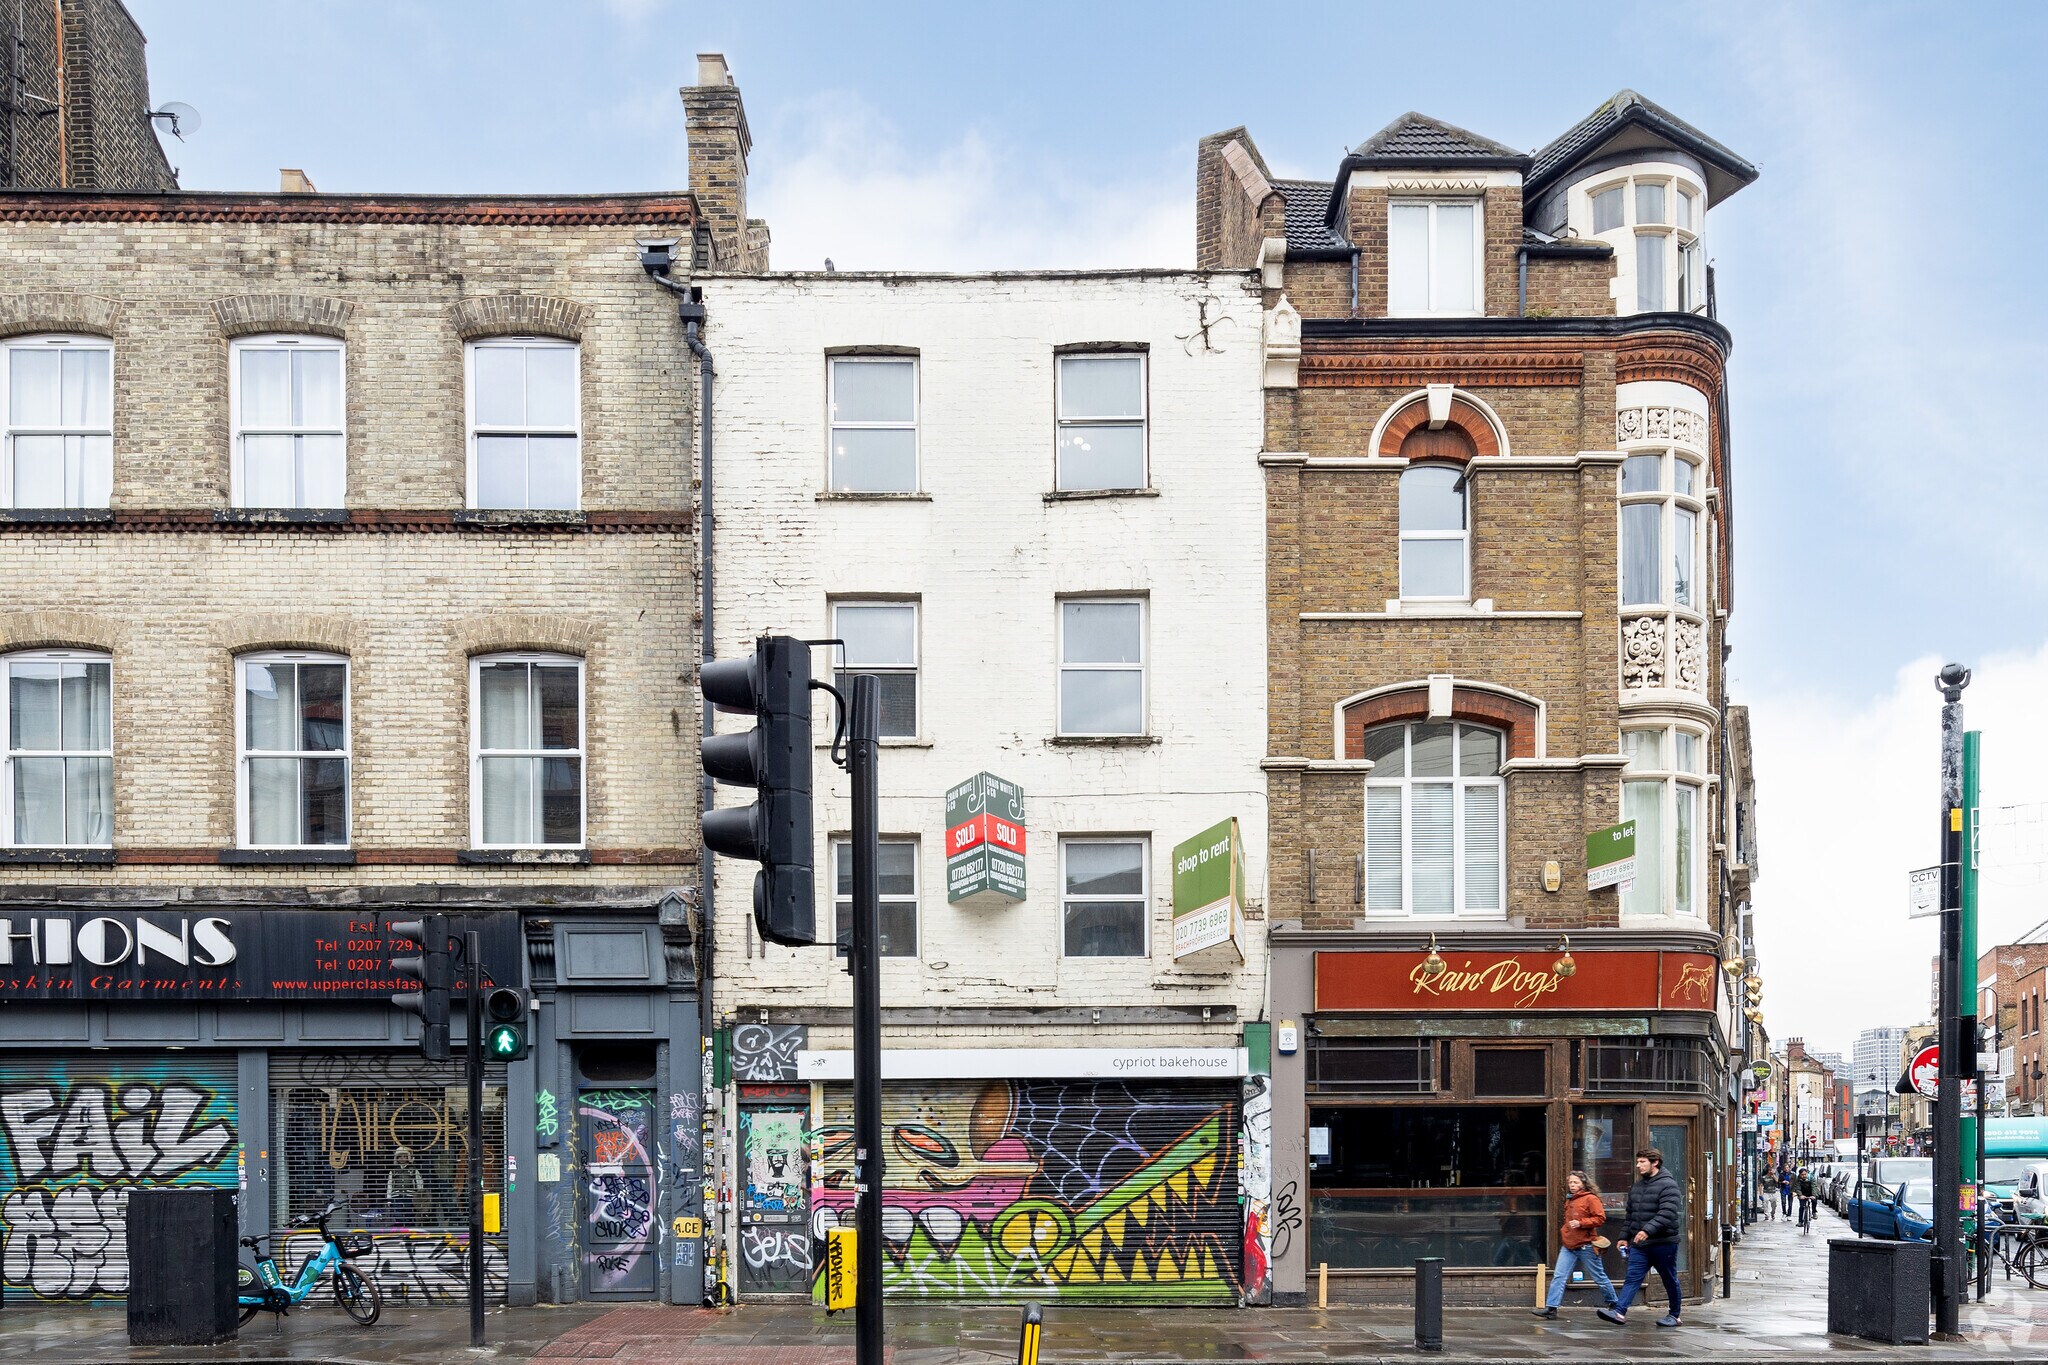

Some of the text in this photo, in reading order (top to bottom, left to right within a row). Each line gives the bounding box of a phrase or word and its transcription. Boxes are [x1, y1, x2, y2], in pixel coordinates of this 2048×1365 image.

[959, 782, 973, 796] WHITE
[1000, 781, 1014, 796] WHITE
[955, 823, 975, 848] SOLD
[996, 822, 1017, 846] SOLD
[1612, 826, 1634, 841] to let
[1177, 853, 1198, 875] shop
[1199, 848, 1209, 863] to
[1210, 835, 1230, 859] rent
[1911, 871, 1938, 883] CCTV
[1175, 909, 1228, 941] 020 7739 6969
[315, 940, 342, 952] Tel:
[347, 940, 382, 952] 0207
[388, 940, 413, 952] 729
[315, 959, 342, 971] Tel:
[347, 959, 382, 971] 0207
[90, 975, 243, 990] Garments
[1409, 955, 1565, 1009] Rain Dogs
[1112, 1056, 1228, 1070] cypriot bakehouse
[262, 1263, 277, 1286] forest
